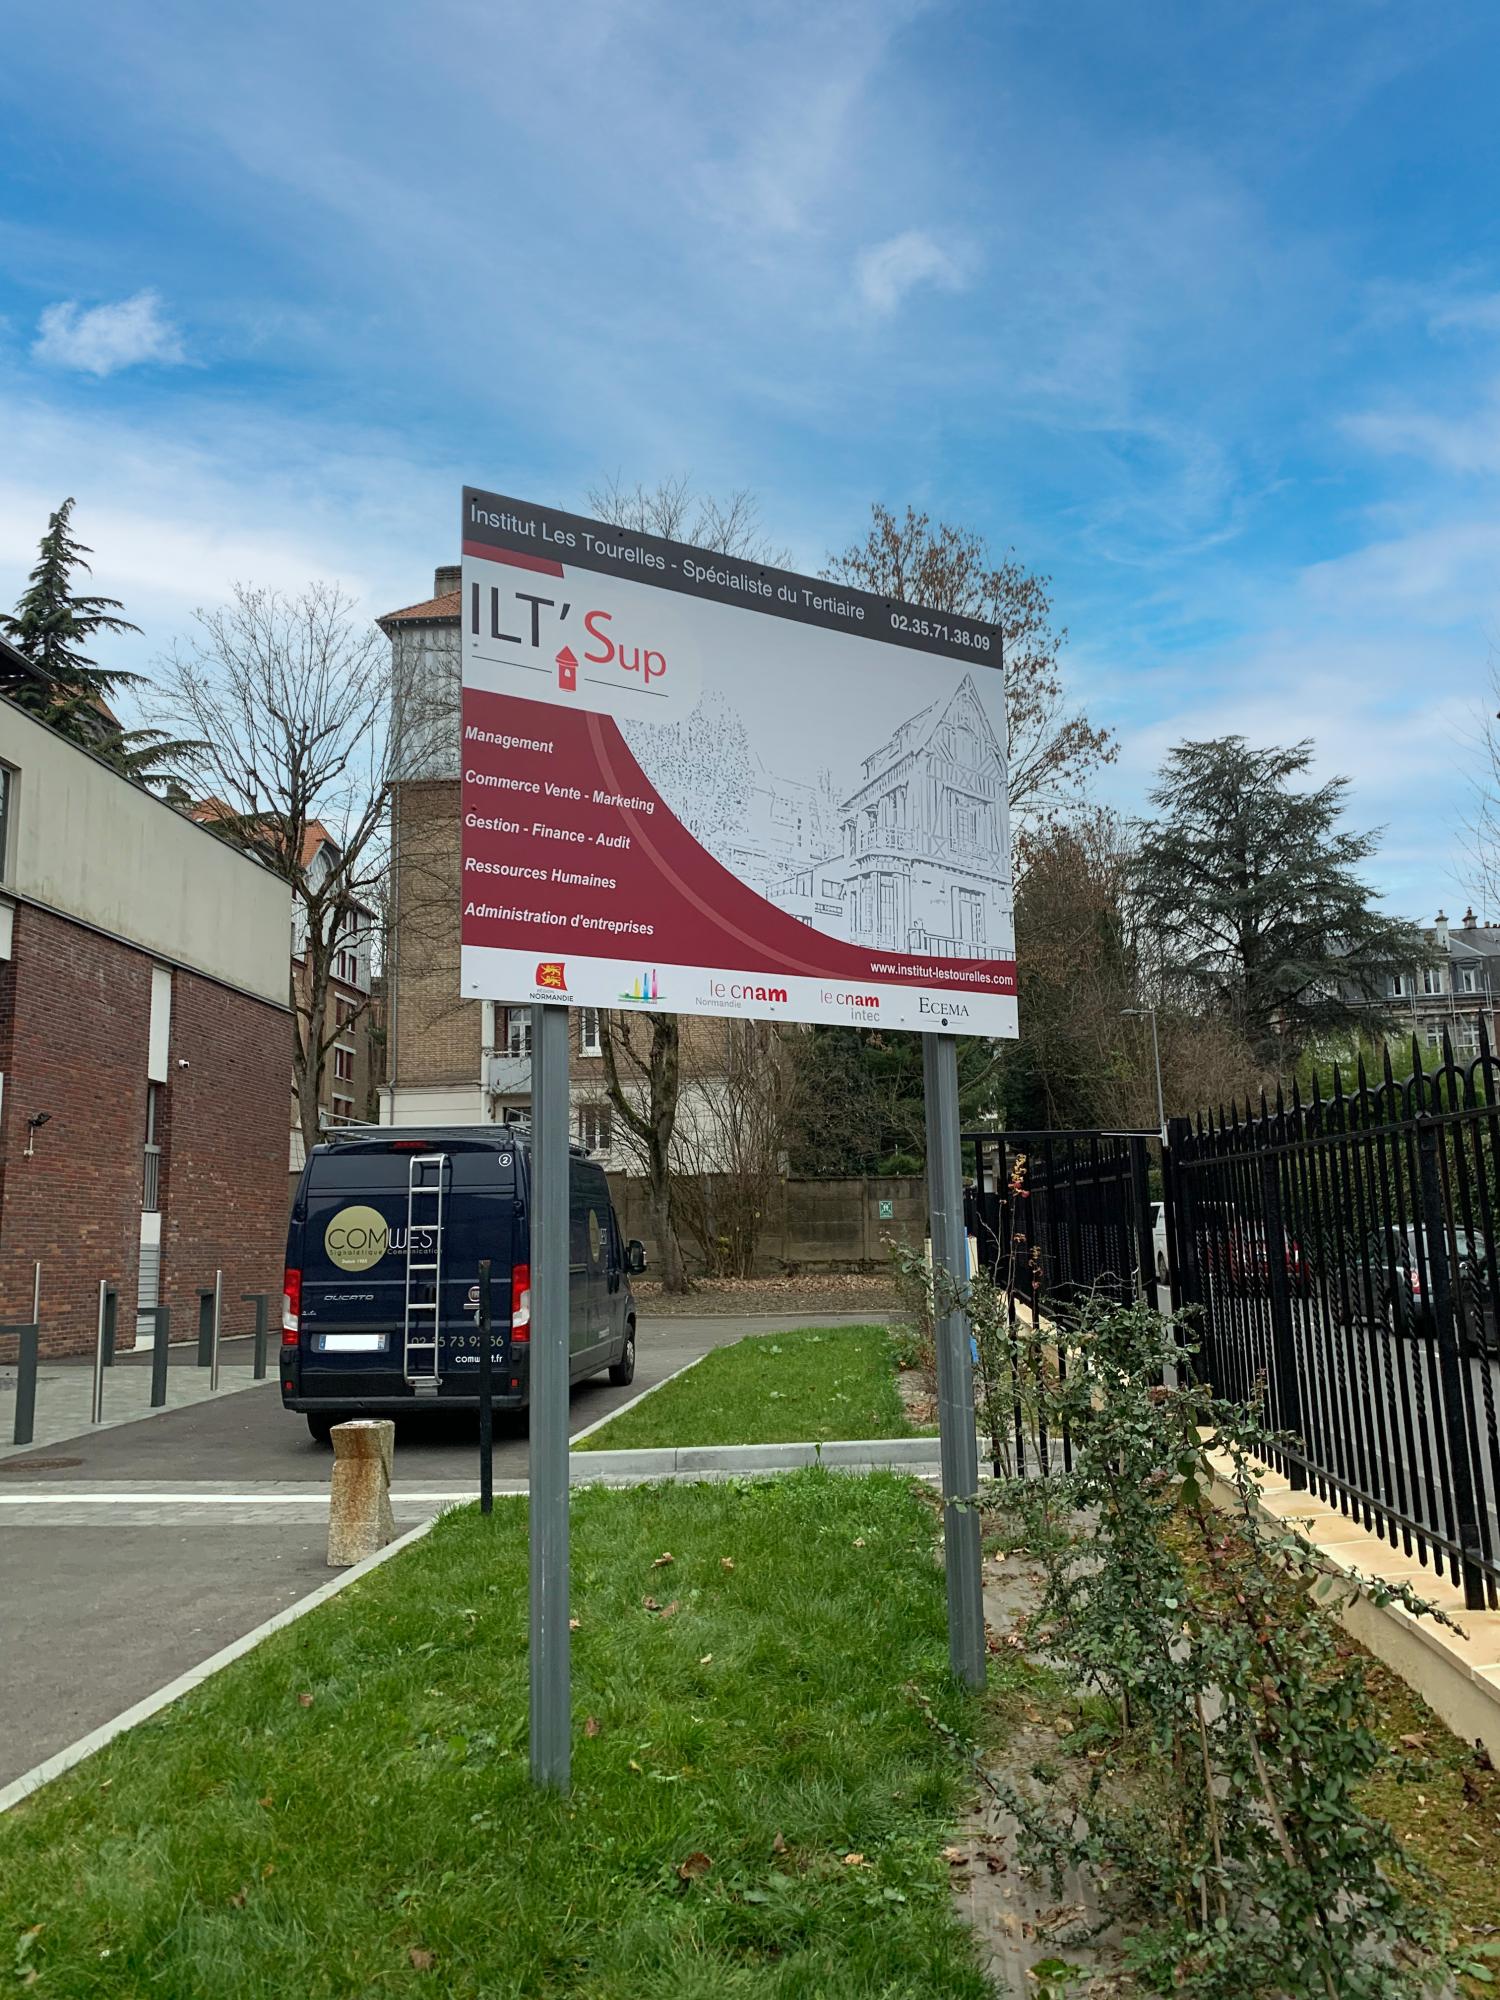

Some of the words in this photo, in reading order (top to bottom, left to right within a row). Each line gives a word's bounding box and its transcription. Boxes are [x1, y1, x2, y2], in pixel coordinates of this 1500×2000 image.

[471, 504, 535, 537] Institut
[542, 522, 576, 547] Les
[581, 532, 666, 570] Tourelles
[683, 559, 772, 598] Spécialiste
[777, 585, 797, 604] du
[801, 589, 865, 620] Tertiaire
[890, 613, 990, 651] 02.35.71.38.09
[465, 725, 554, 754] Management
[465, 769, 540, 793] Commerce
[544, 782, 581, 800] Vente
[592, 790, 655, 814] Marketing
[465, 813, 520, 834] Gestion
[532, 822, 585, 843] Finance
[595, 832, 631, 850] Audit
[465, 857, 547, 880] Ressources
[551, 868, 617, 889] Humaines
[464, 902, 567, 926] Administration
[570, 913, 654, 936] d'entreprises
[870, 962, 1014, 986] www.institut-lestourelles.com
[529, 992, 574, 1002] NORMANDIE
[695, 997, 742, 1009] Normandie
[710, 979, 726, 998] le
[730, 983, 788, 1003] cnam
[820, 989, 833, 1005] le
[836, 993, 880, 1008] cnam
[851, 1008, 880, 1022] intec
[918, 997, 970, 1017] ECEMA
[450, 1335, 465, 1348] 73
[455, 1353, 503, 1363] comwt.fr
